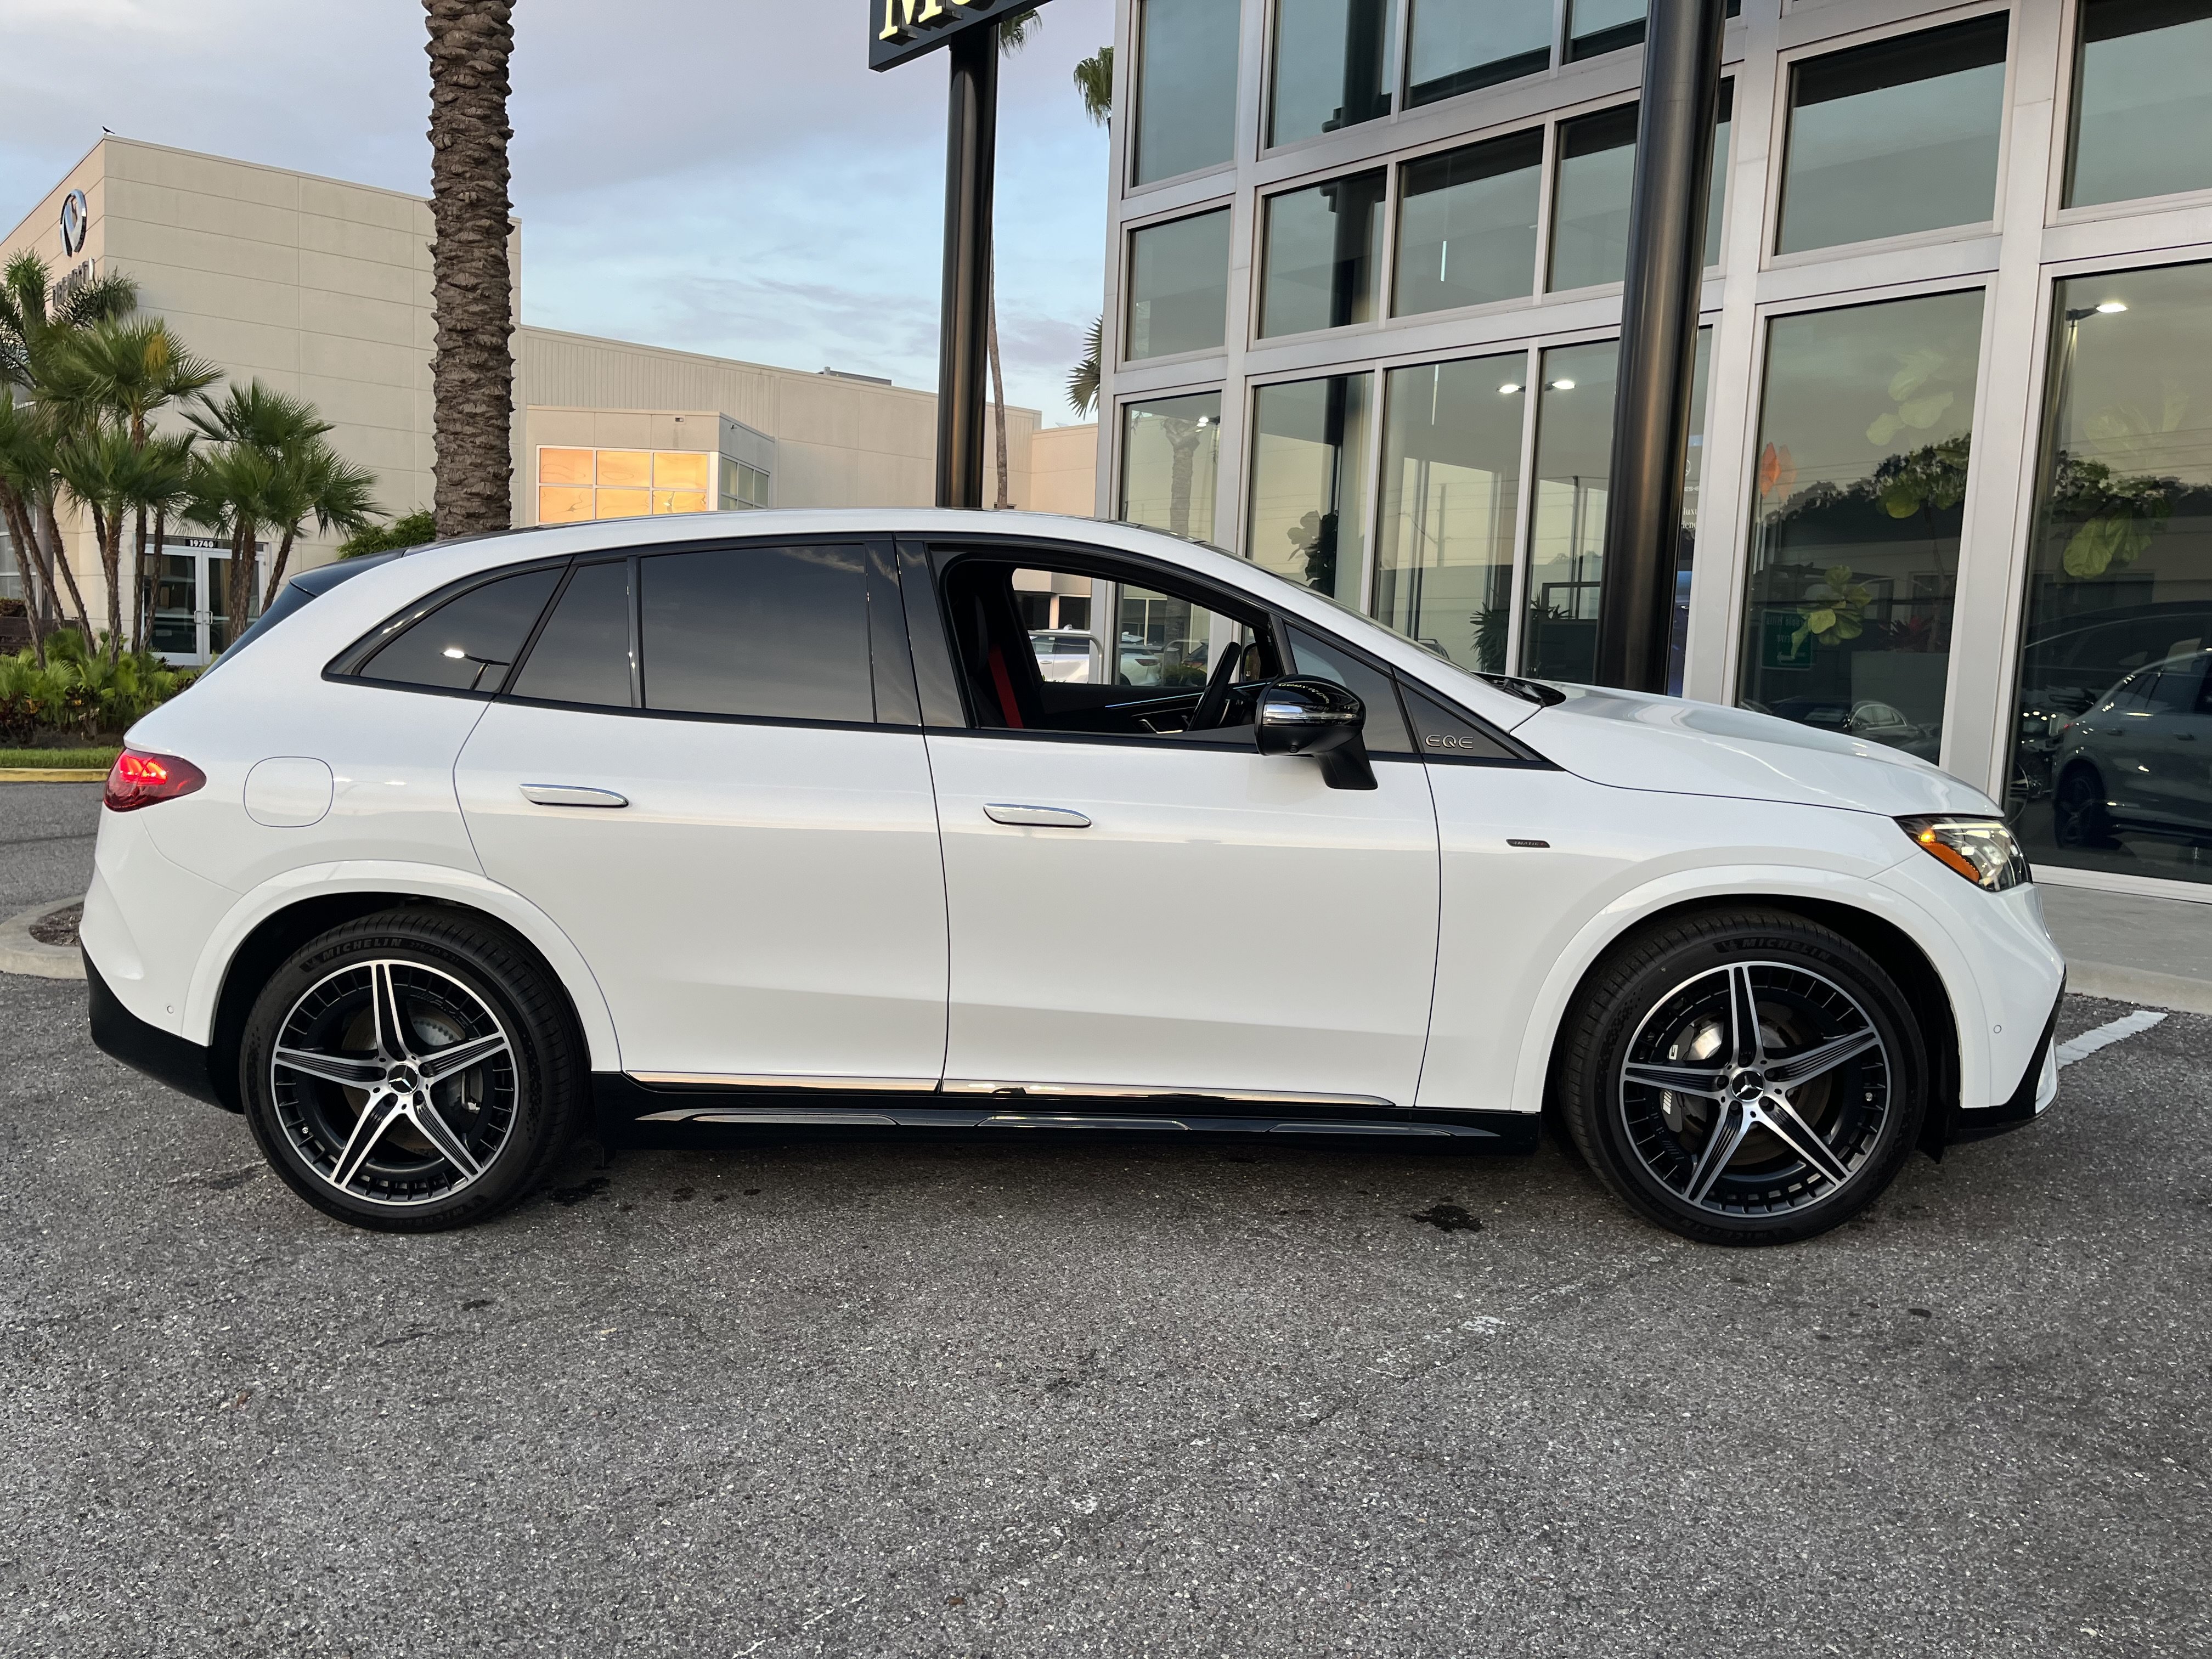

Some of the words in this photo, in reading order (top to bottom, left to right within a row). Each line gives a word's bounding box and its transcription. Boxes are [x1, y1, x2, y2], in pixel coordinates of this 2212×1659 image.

[190, 539, 214, 548] 19740
[1425, 735, 1474, 748] EQE
[323, 938, 402, 962] MICHELIN
[1741, 938, 1831, 961] MICHELIN
